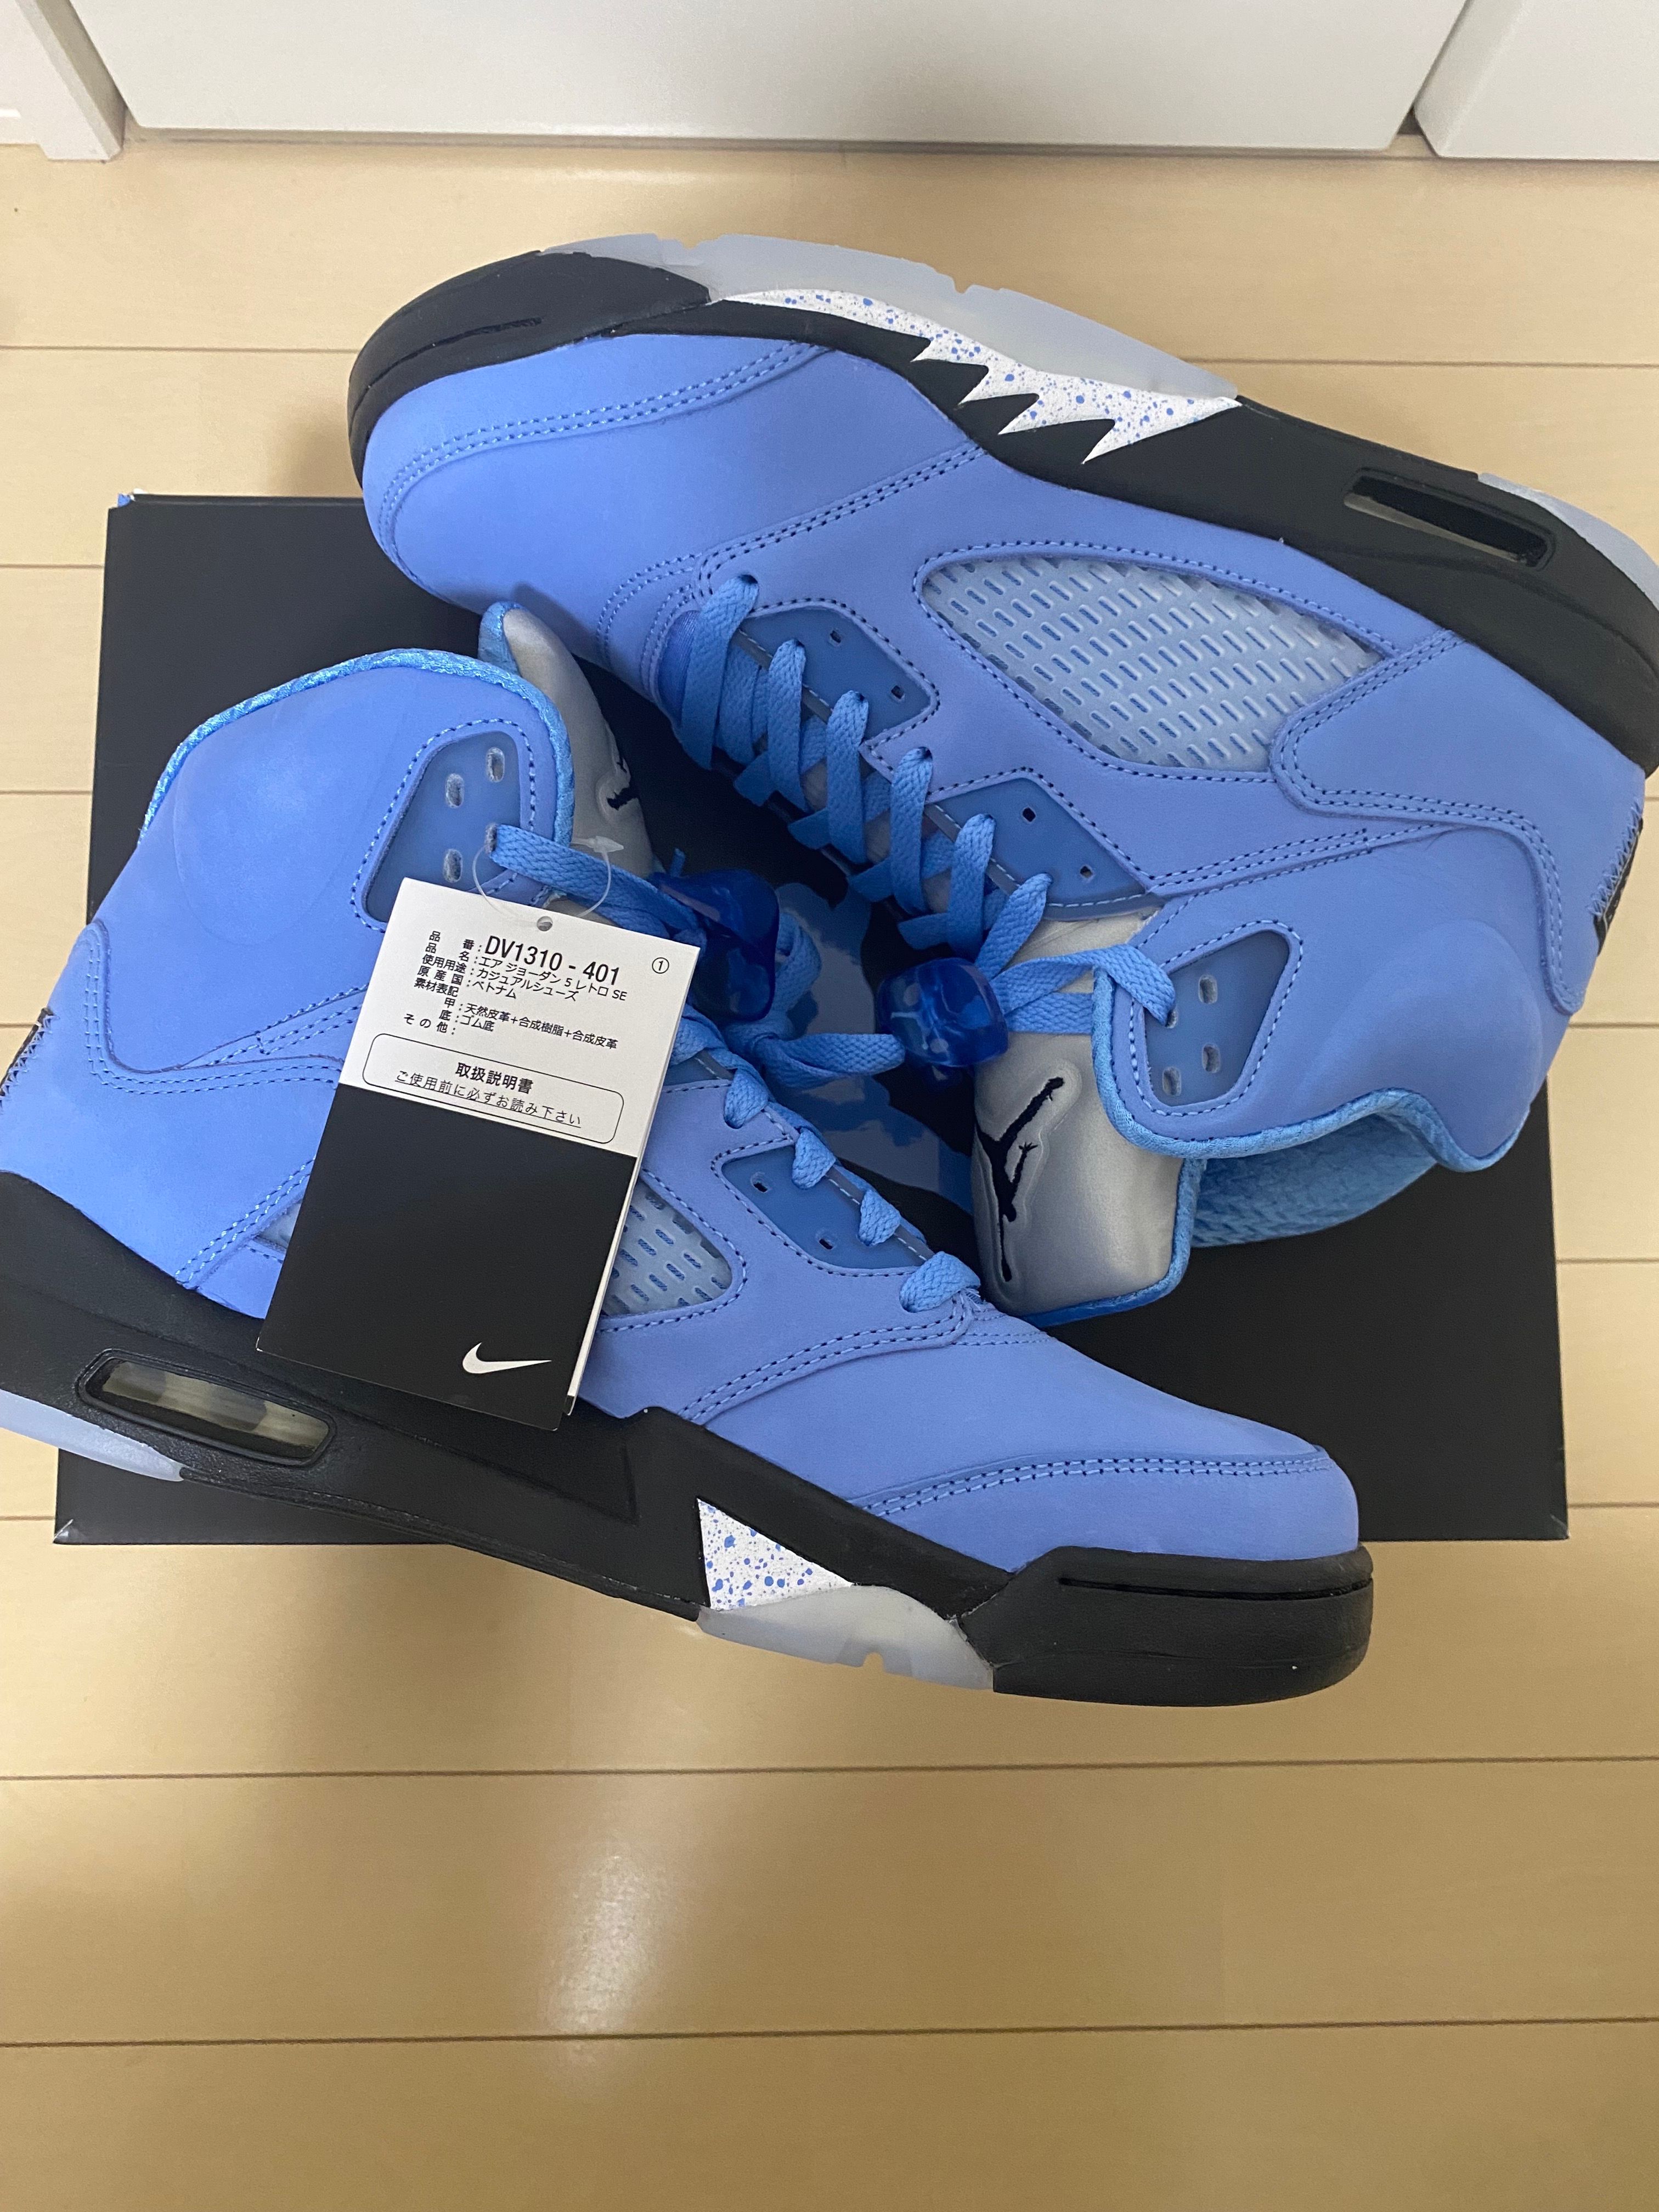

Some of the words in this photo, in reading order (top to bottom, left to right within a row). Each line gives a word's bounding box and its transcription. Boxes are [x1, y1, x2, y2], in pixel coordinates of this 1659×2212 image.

[484, 935, 563, 972] DV1310
[583, 961, 620, 986] 401
[414, 977, 459, 997] 素材表記
[612, 990, 628, 1001] SE
[455, 1062, 534, 1094] 取扱説明書
[396, 1070, 581, 1125] ご使用前に必ずお読み下さい
